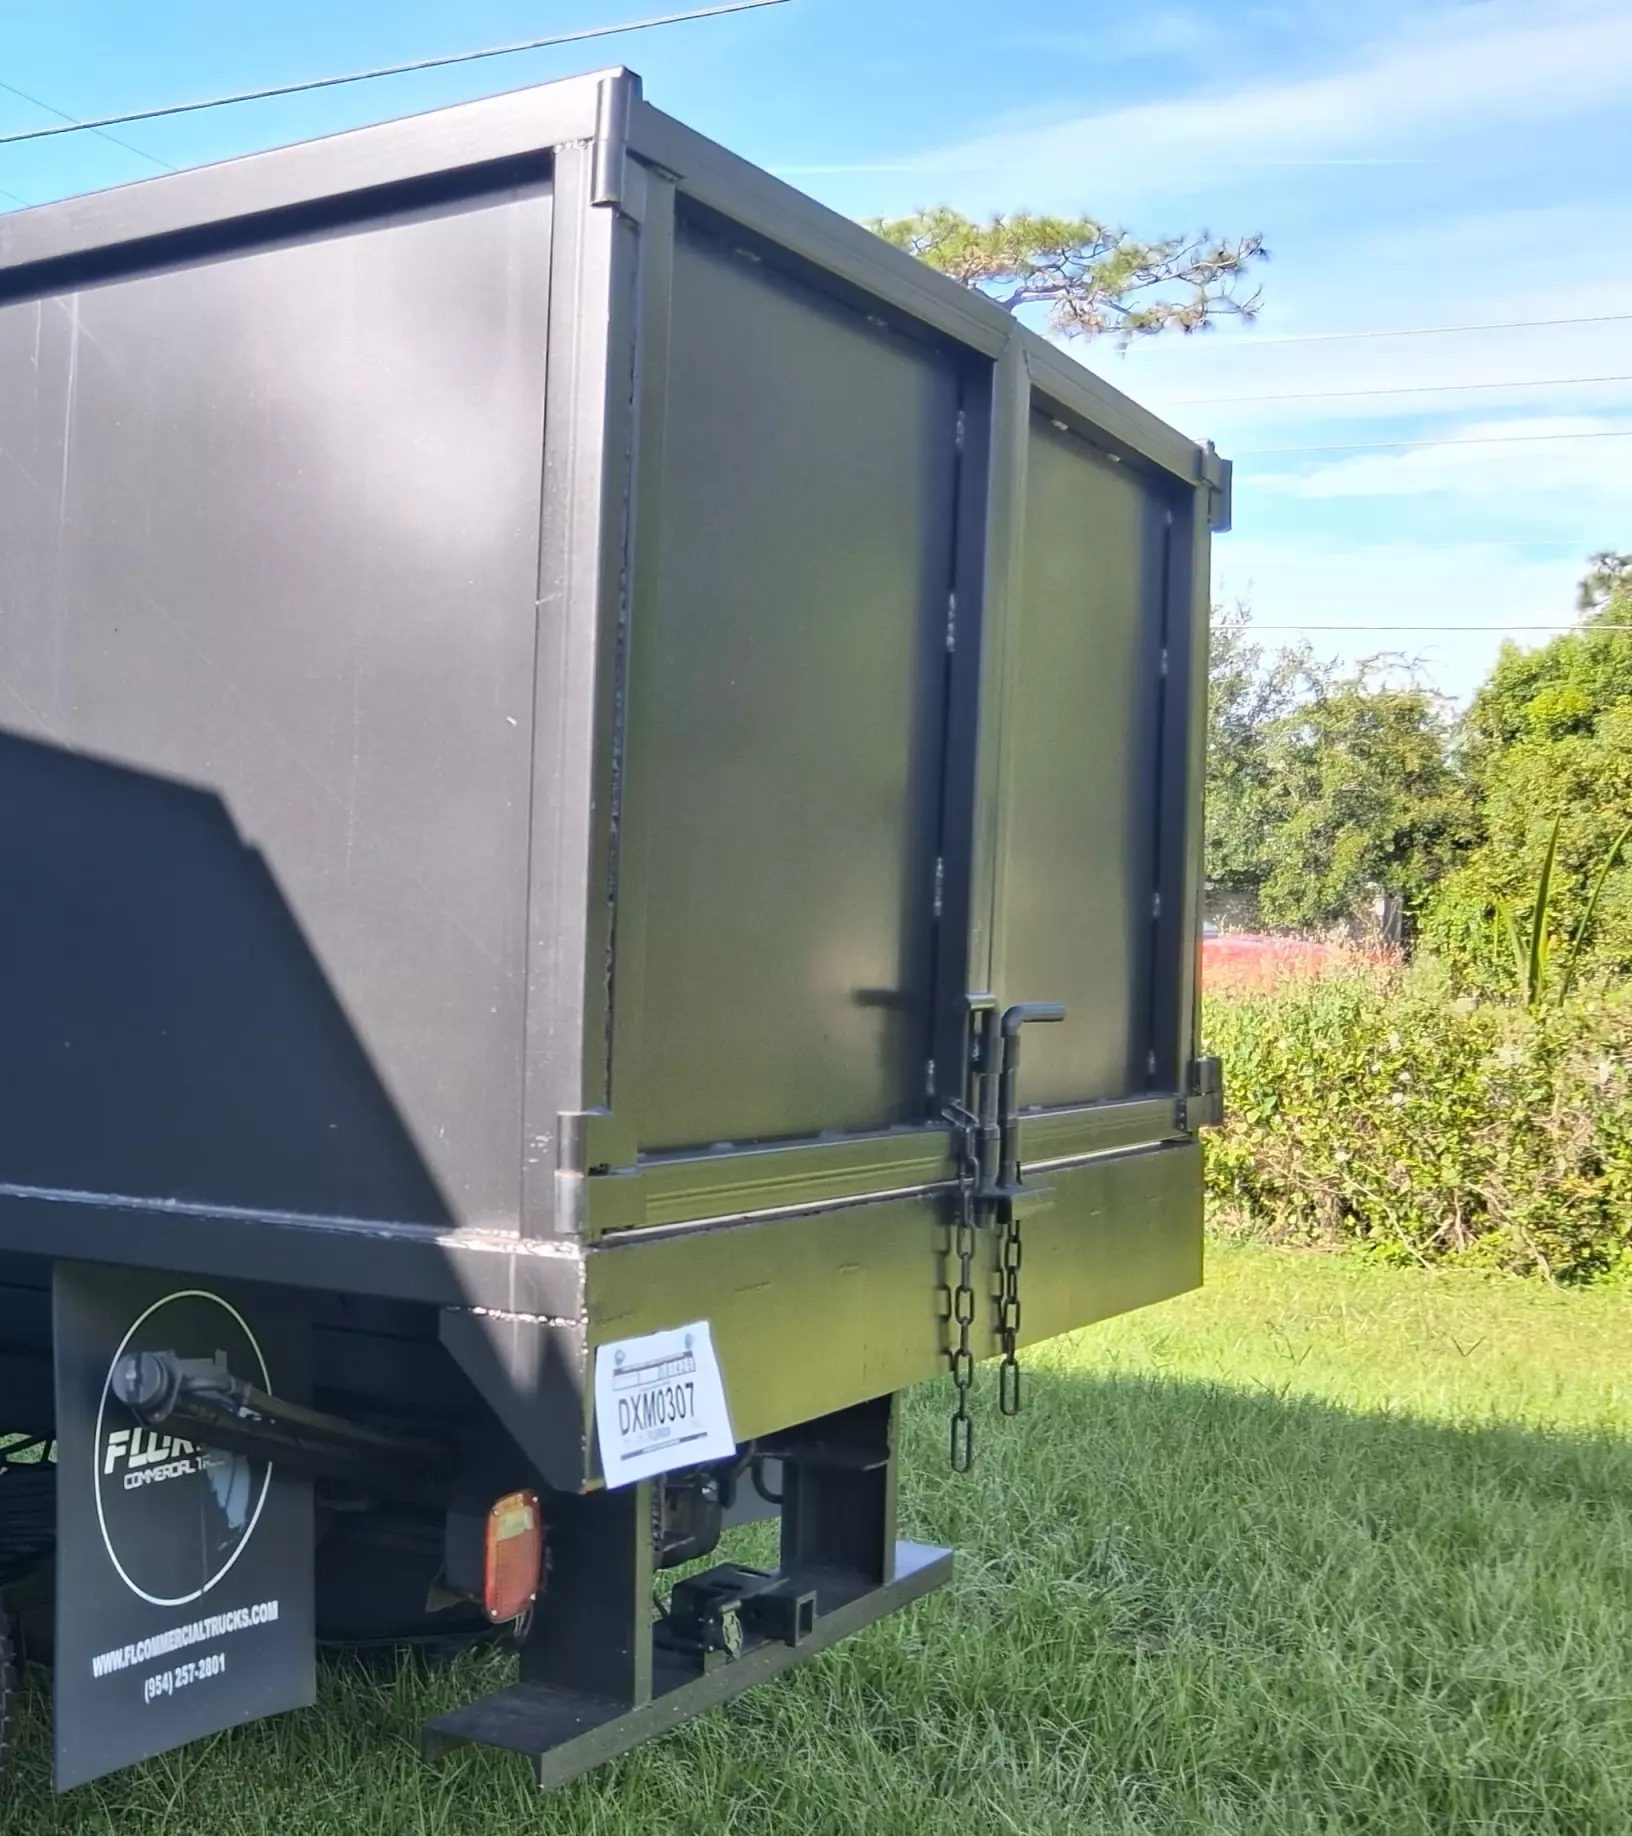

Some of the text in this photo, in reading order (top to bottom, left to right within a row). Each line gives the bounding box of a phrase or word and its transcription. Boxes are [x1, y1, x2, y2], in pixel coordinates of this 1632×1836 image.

[618, 1382, 695, 1436] DXM0307
[92, 1600, 279, 1678] WWW.FLCOMMERCIALTRUCKS.COM
[144, 1652, 226, 1704] (954) 257-2801
